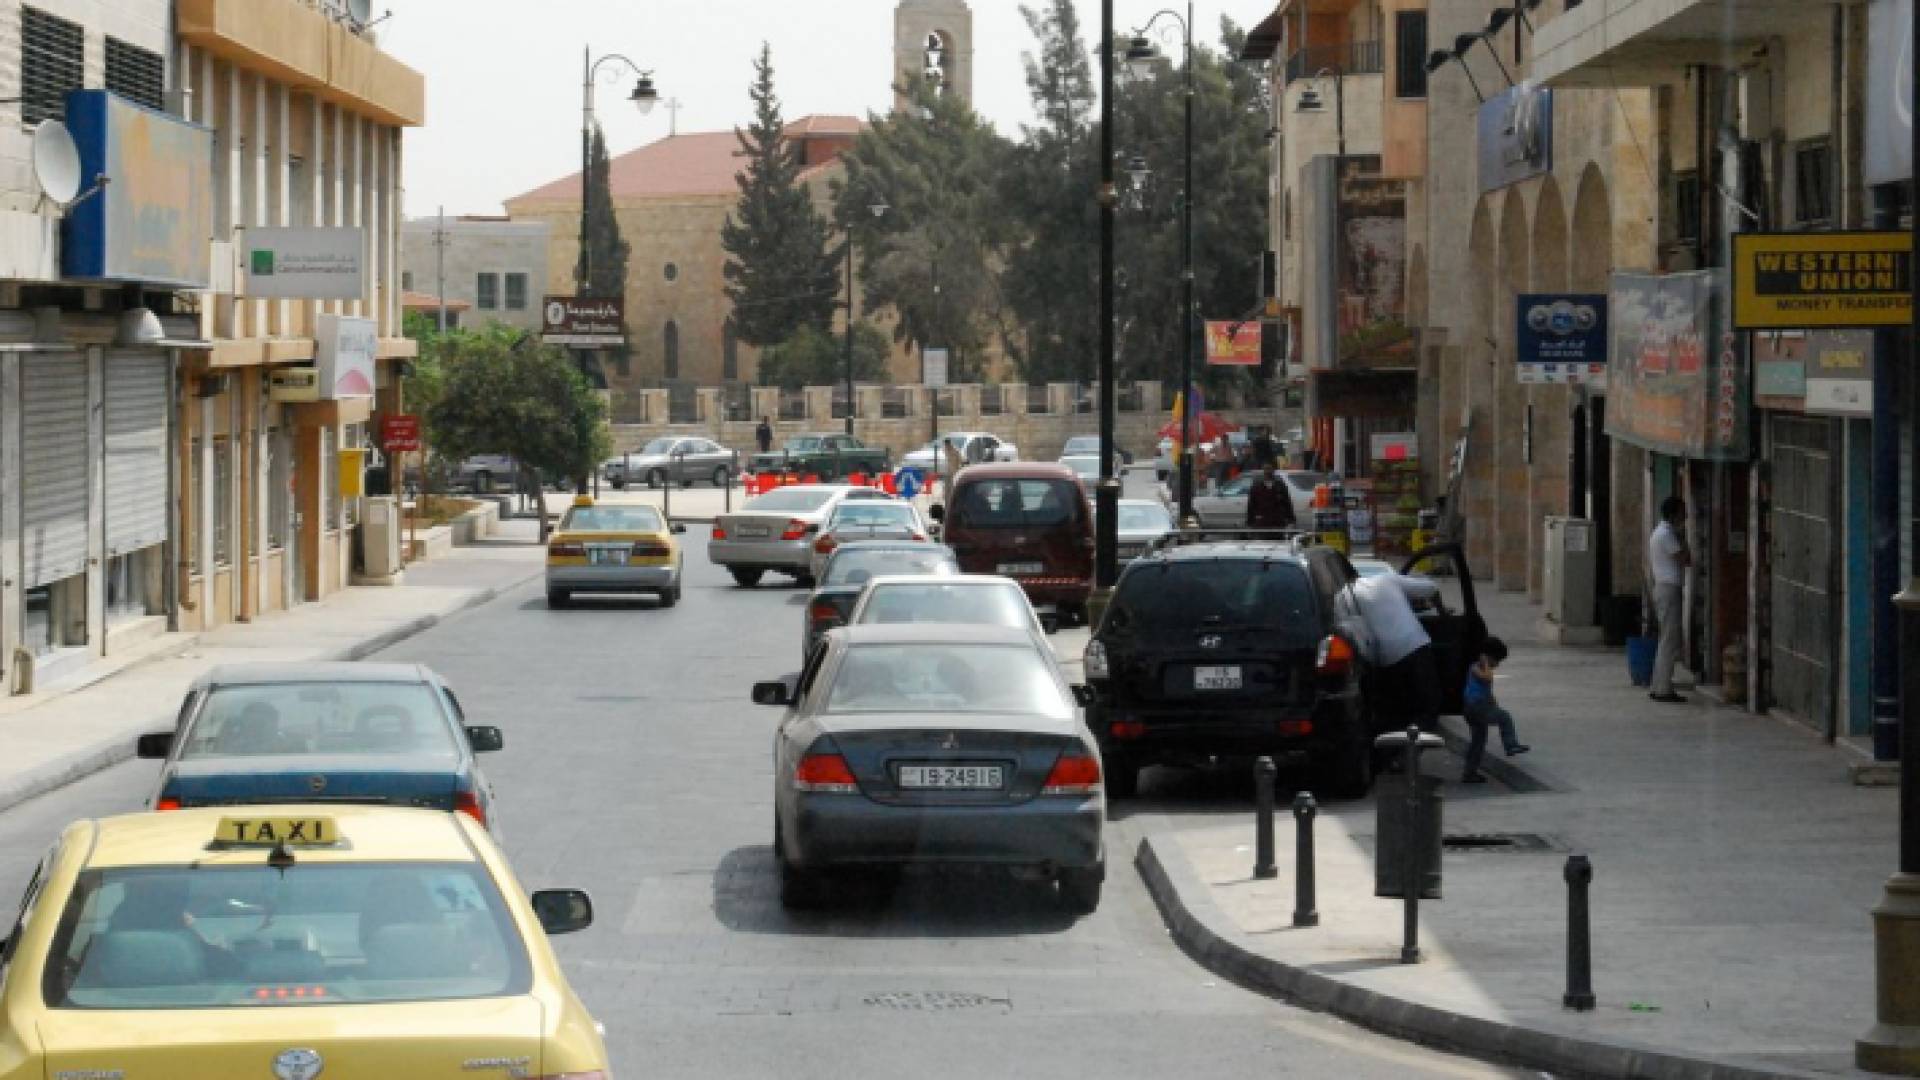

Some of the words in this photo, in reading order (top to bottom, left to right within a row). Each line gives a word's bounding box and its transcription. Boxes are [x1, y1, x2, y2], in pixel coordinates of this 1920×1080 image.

[1757, 253, 1892, 271] WESTERN
[1801, 272, 1892, 290] UNION
[1776, 297, 1831, 311] MONEY
[232, 820, 322, 841] TAXI
